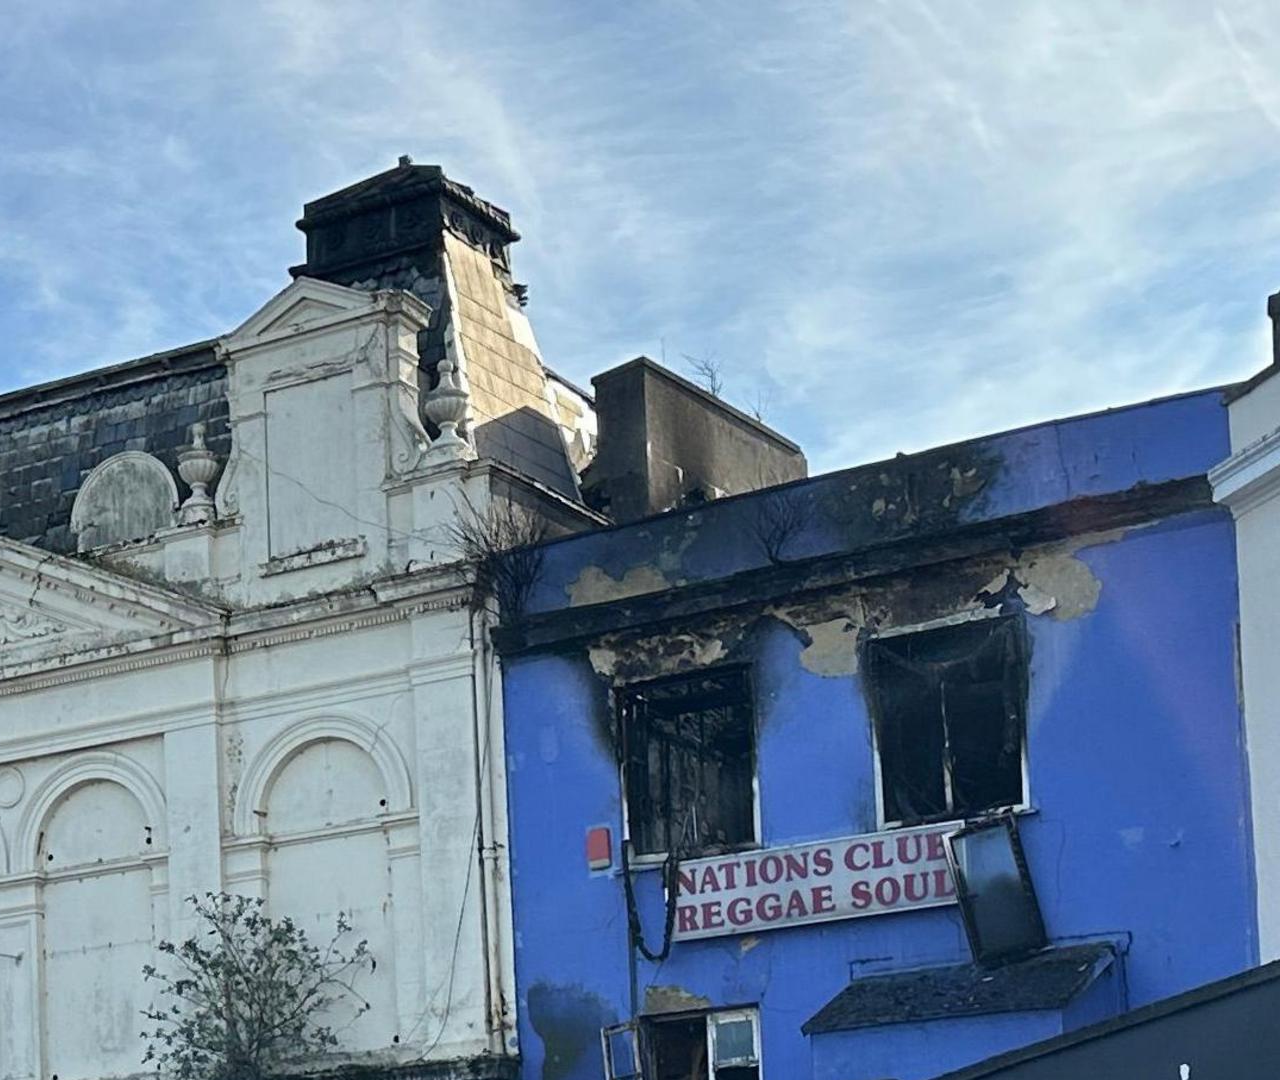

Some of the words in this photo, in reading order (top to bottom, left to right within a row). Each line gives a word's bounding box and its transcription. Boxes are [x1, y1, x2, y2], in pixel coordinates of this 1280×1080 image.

[677, 848, 833, 897] NATIONS
[678, 885, 836, 932] REGGAE
[851, 869, 957, 910] SOUL
